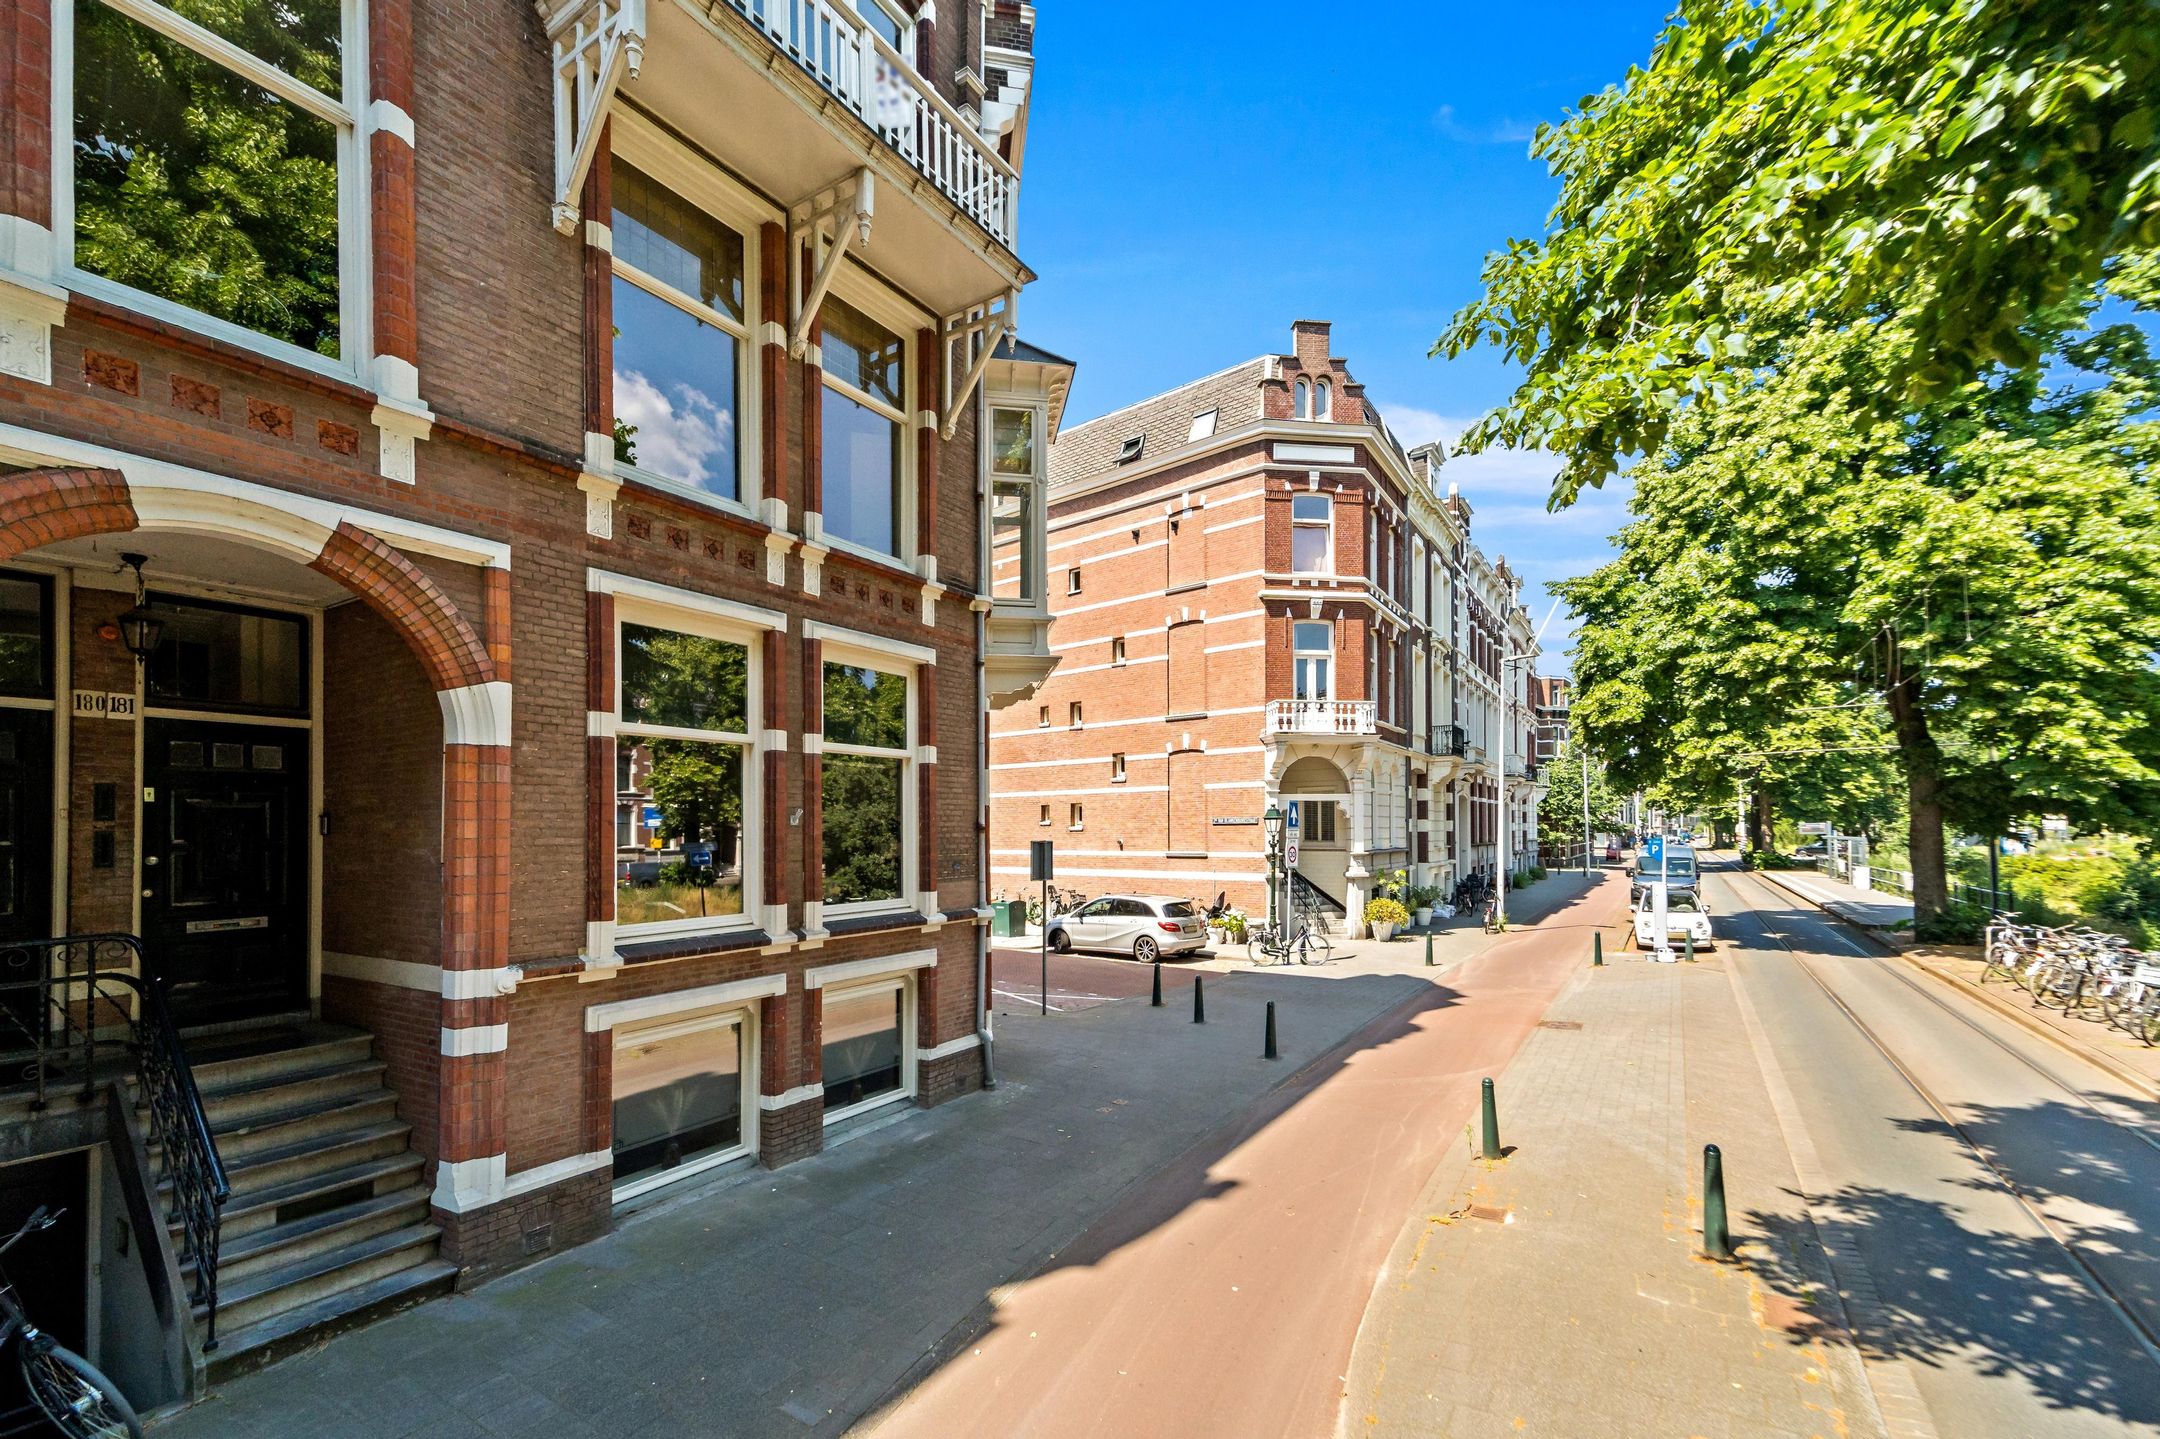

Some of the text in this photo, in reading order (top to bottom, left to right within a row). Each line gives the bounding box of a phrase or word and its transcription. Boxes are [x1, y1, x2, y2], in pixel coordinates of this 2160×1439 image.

[75, 694, 106, 711] 180
[110, 697, 135, 714] 181
[1651, 845, 1659, 855] P
